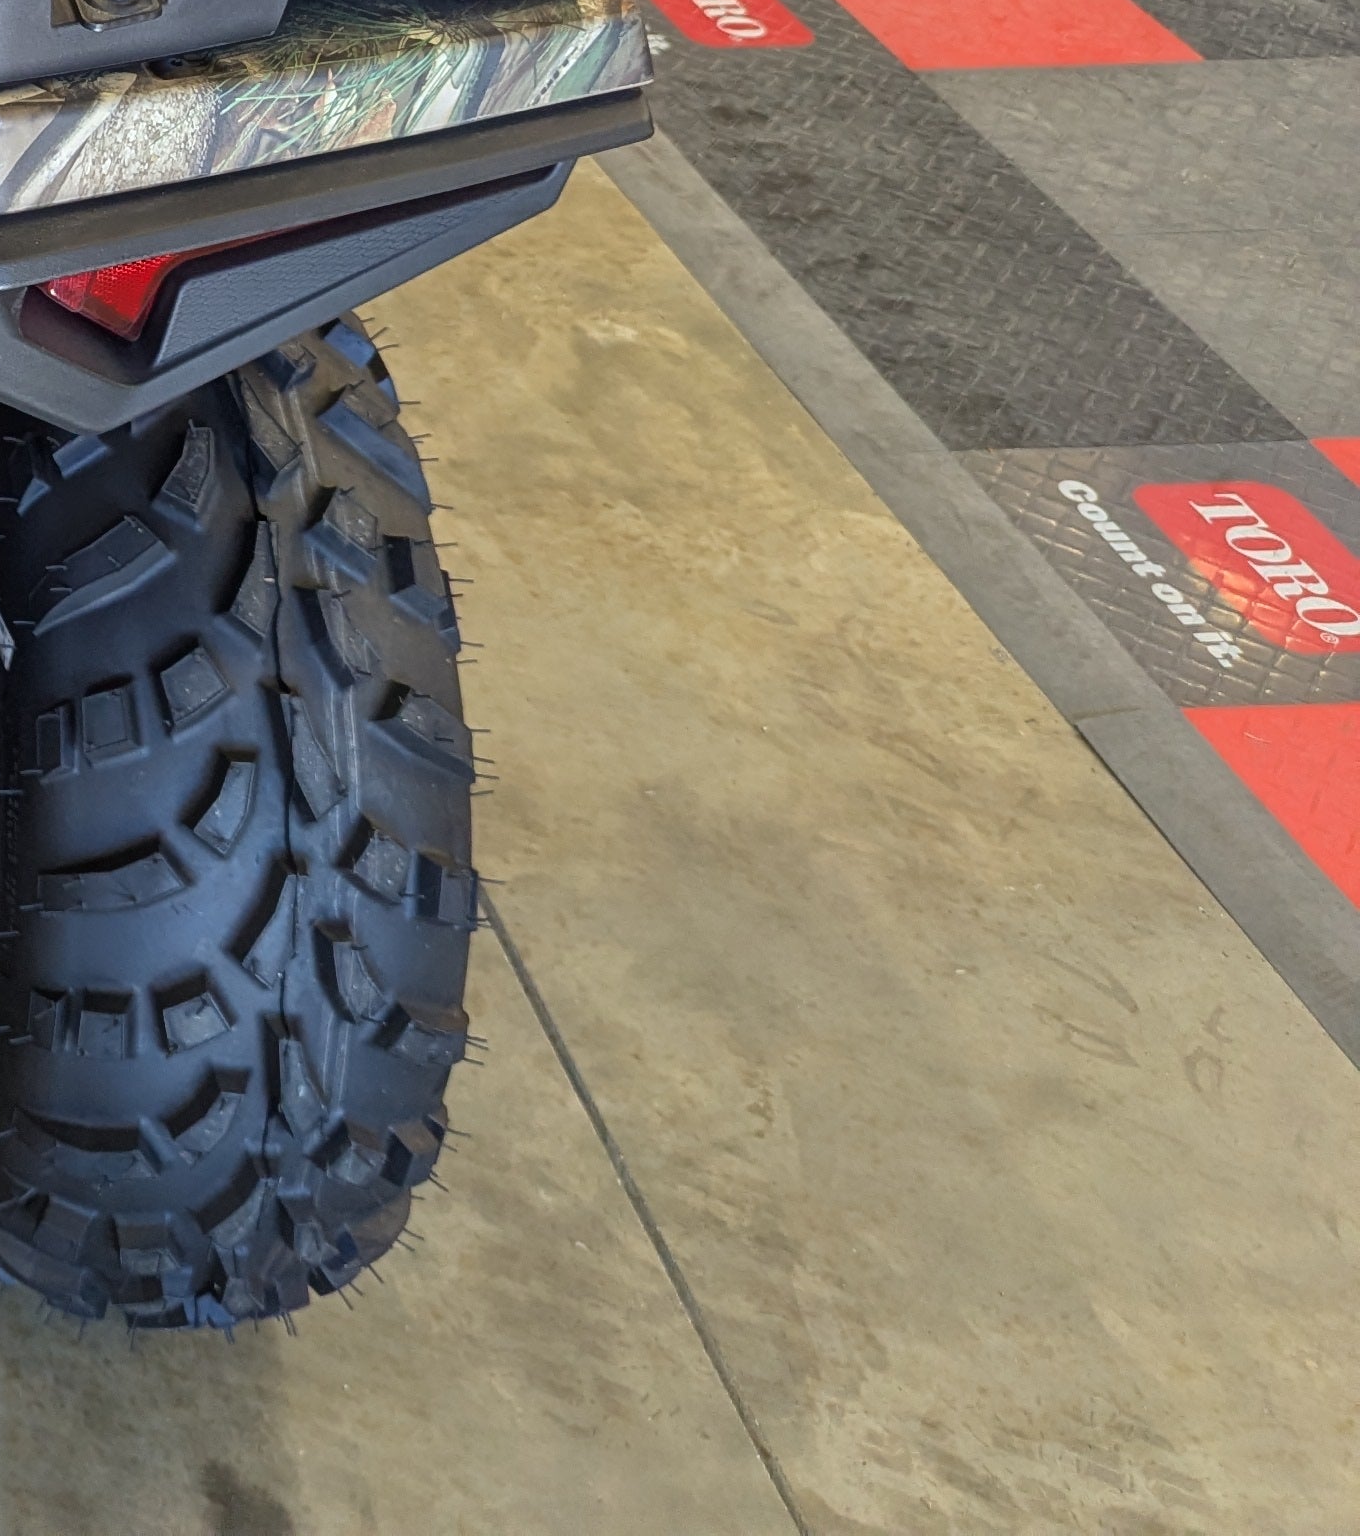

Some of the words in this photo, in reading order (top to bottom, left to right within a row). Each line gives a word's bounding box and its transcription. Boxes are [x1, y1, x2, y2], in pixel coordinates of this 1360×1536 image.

[1057, 480, 1167, 579] Count
[1150, 583, 1207, 626] on
[1192, 632, 1245, 669] it.
[1188, 493, 1360, 637] TORO
